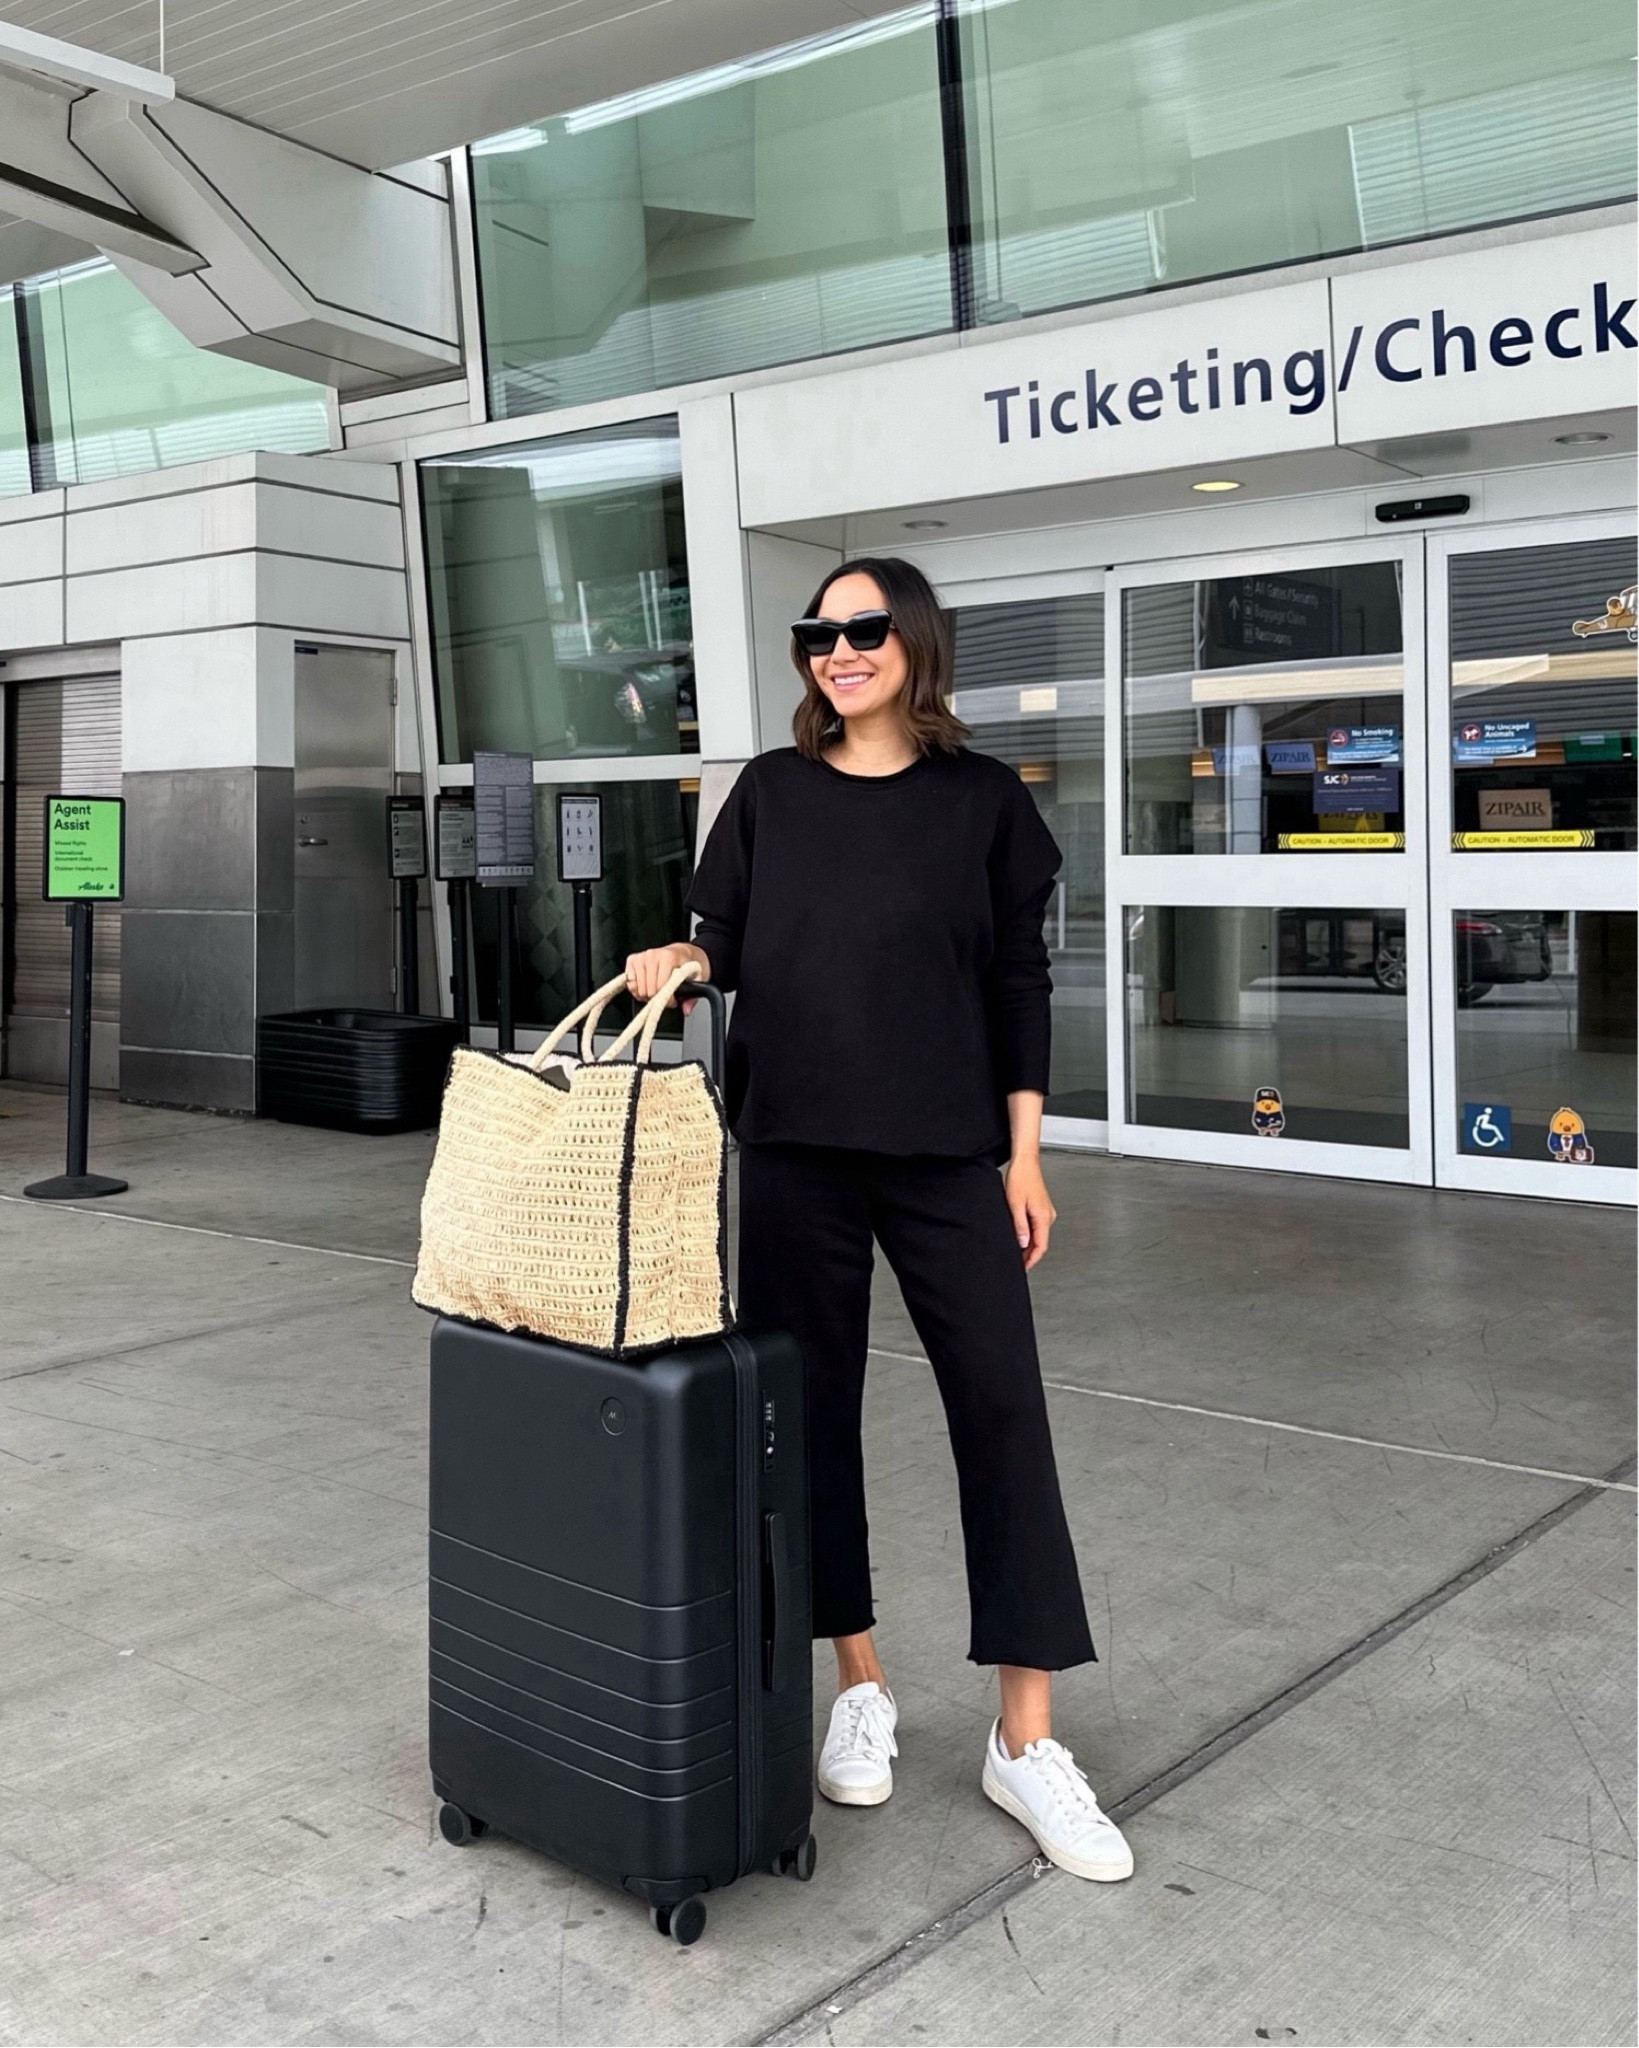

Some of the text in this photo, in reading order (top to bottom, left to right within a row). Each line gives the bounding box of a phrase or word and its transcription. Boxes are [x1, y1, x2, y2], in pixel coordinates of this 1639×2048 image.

[984, 282, 1638, 443] Ticketing/Check
[1363, 728, 1394, 737] Smoking
[1497, 722, 1530, 732] Uncaged
[1271, 752, 1310, 763] ZIPAIR
[1323, 774, 1341, 785] SJC
[54, 803, 91, 817] Agent
[1485, 801, 1546, 817] ZIPAIR
[54, 819, 90, 831] Assist
[1292, 837, 1322, 845] CAUTION
[1467, 836, 1500, 844] CAUTION
